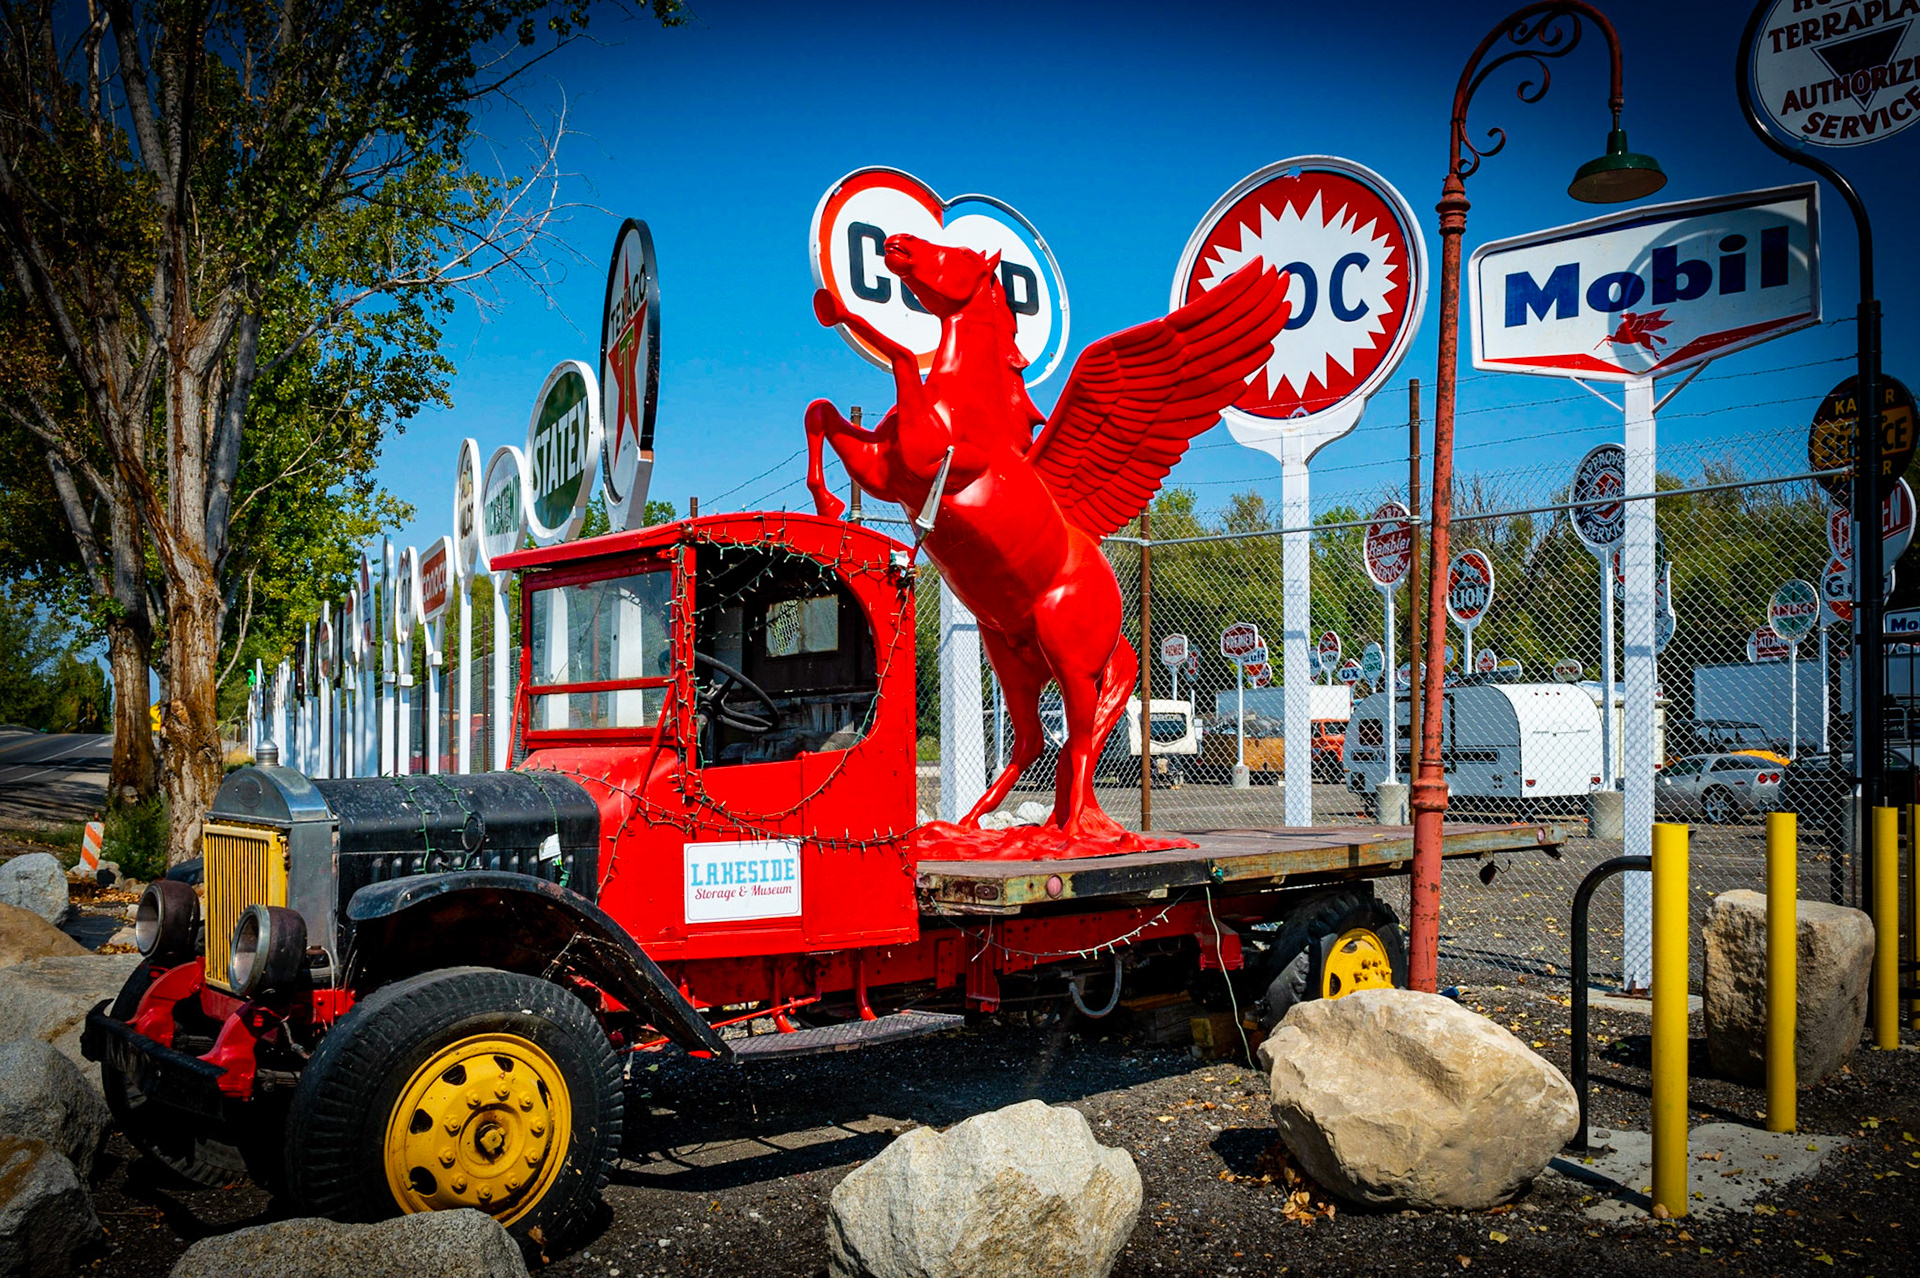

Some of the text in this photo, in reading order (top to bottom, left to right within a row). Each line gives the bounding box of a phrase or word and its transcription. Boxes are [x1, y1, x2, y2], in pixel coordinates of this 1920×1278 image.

[1801, 85, 1920, 139] SERVICE
[848, 221, 1039, 316] CP
[1505, 225, 1789, 328] Mobil
[610, 263, 646, 340] TEXACO
[618, 323, 635, 414] T
[1584, 518, 1625, 541] SERVIC
[1369, 533, 1410, 557] Rambler
[1453, 586, 1485, 609] LION
[1891, 616, 1920, 632] Mo
[691, 858, 795, 886] LAKESIDE
[695, 884, 792, 902] Storage & Museum
